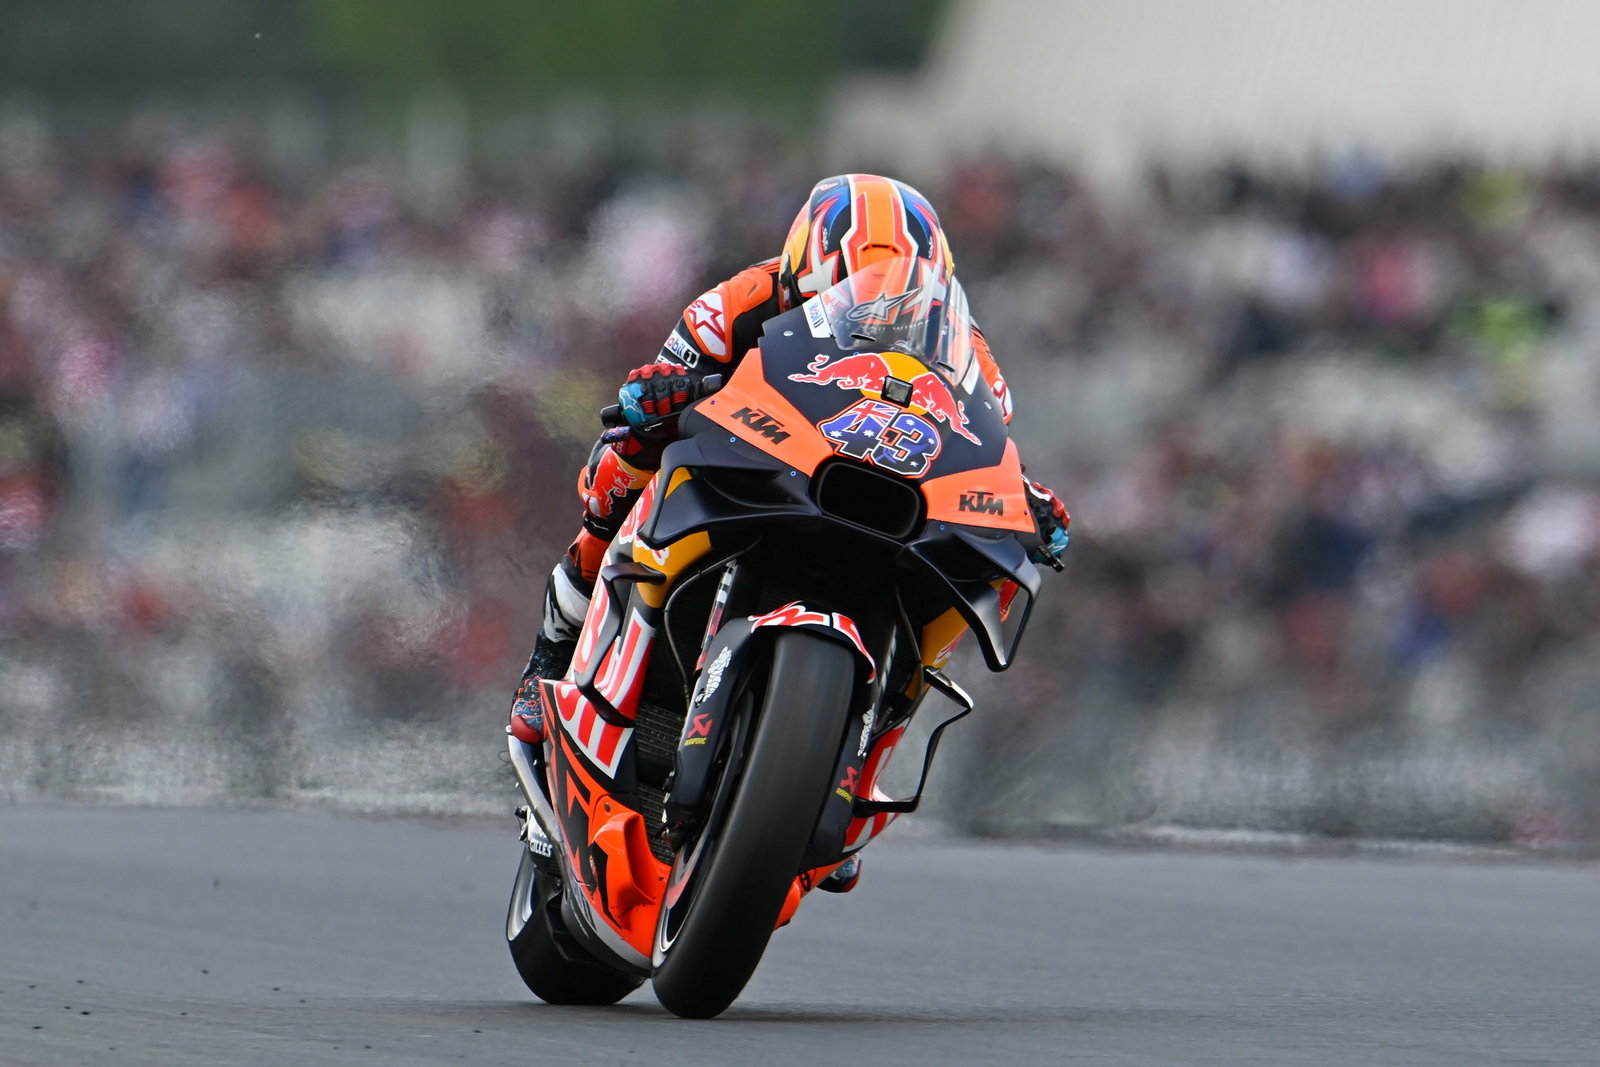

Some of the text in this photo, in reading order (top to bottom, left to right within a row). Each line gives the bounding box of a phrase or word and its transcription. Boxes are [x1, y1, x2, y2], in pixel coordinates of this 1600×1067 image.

[730, 406, 791, 445] KTM
[818, 398, 941, 477] 43
[958, 490, 1004, 516] KTM
